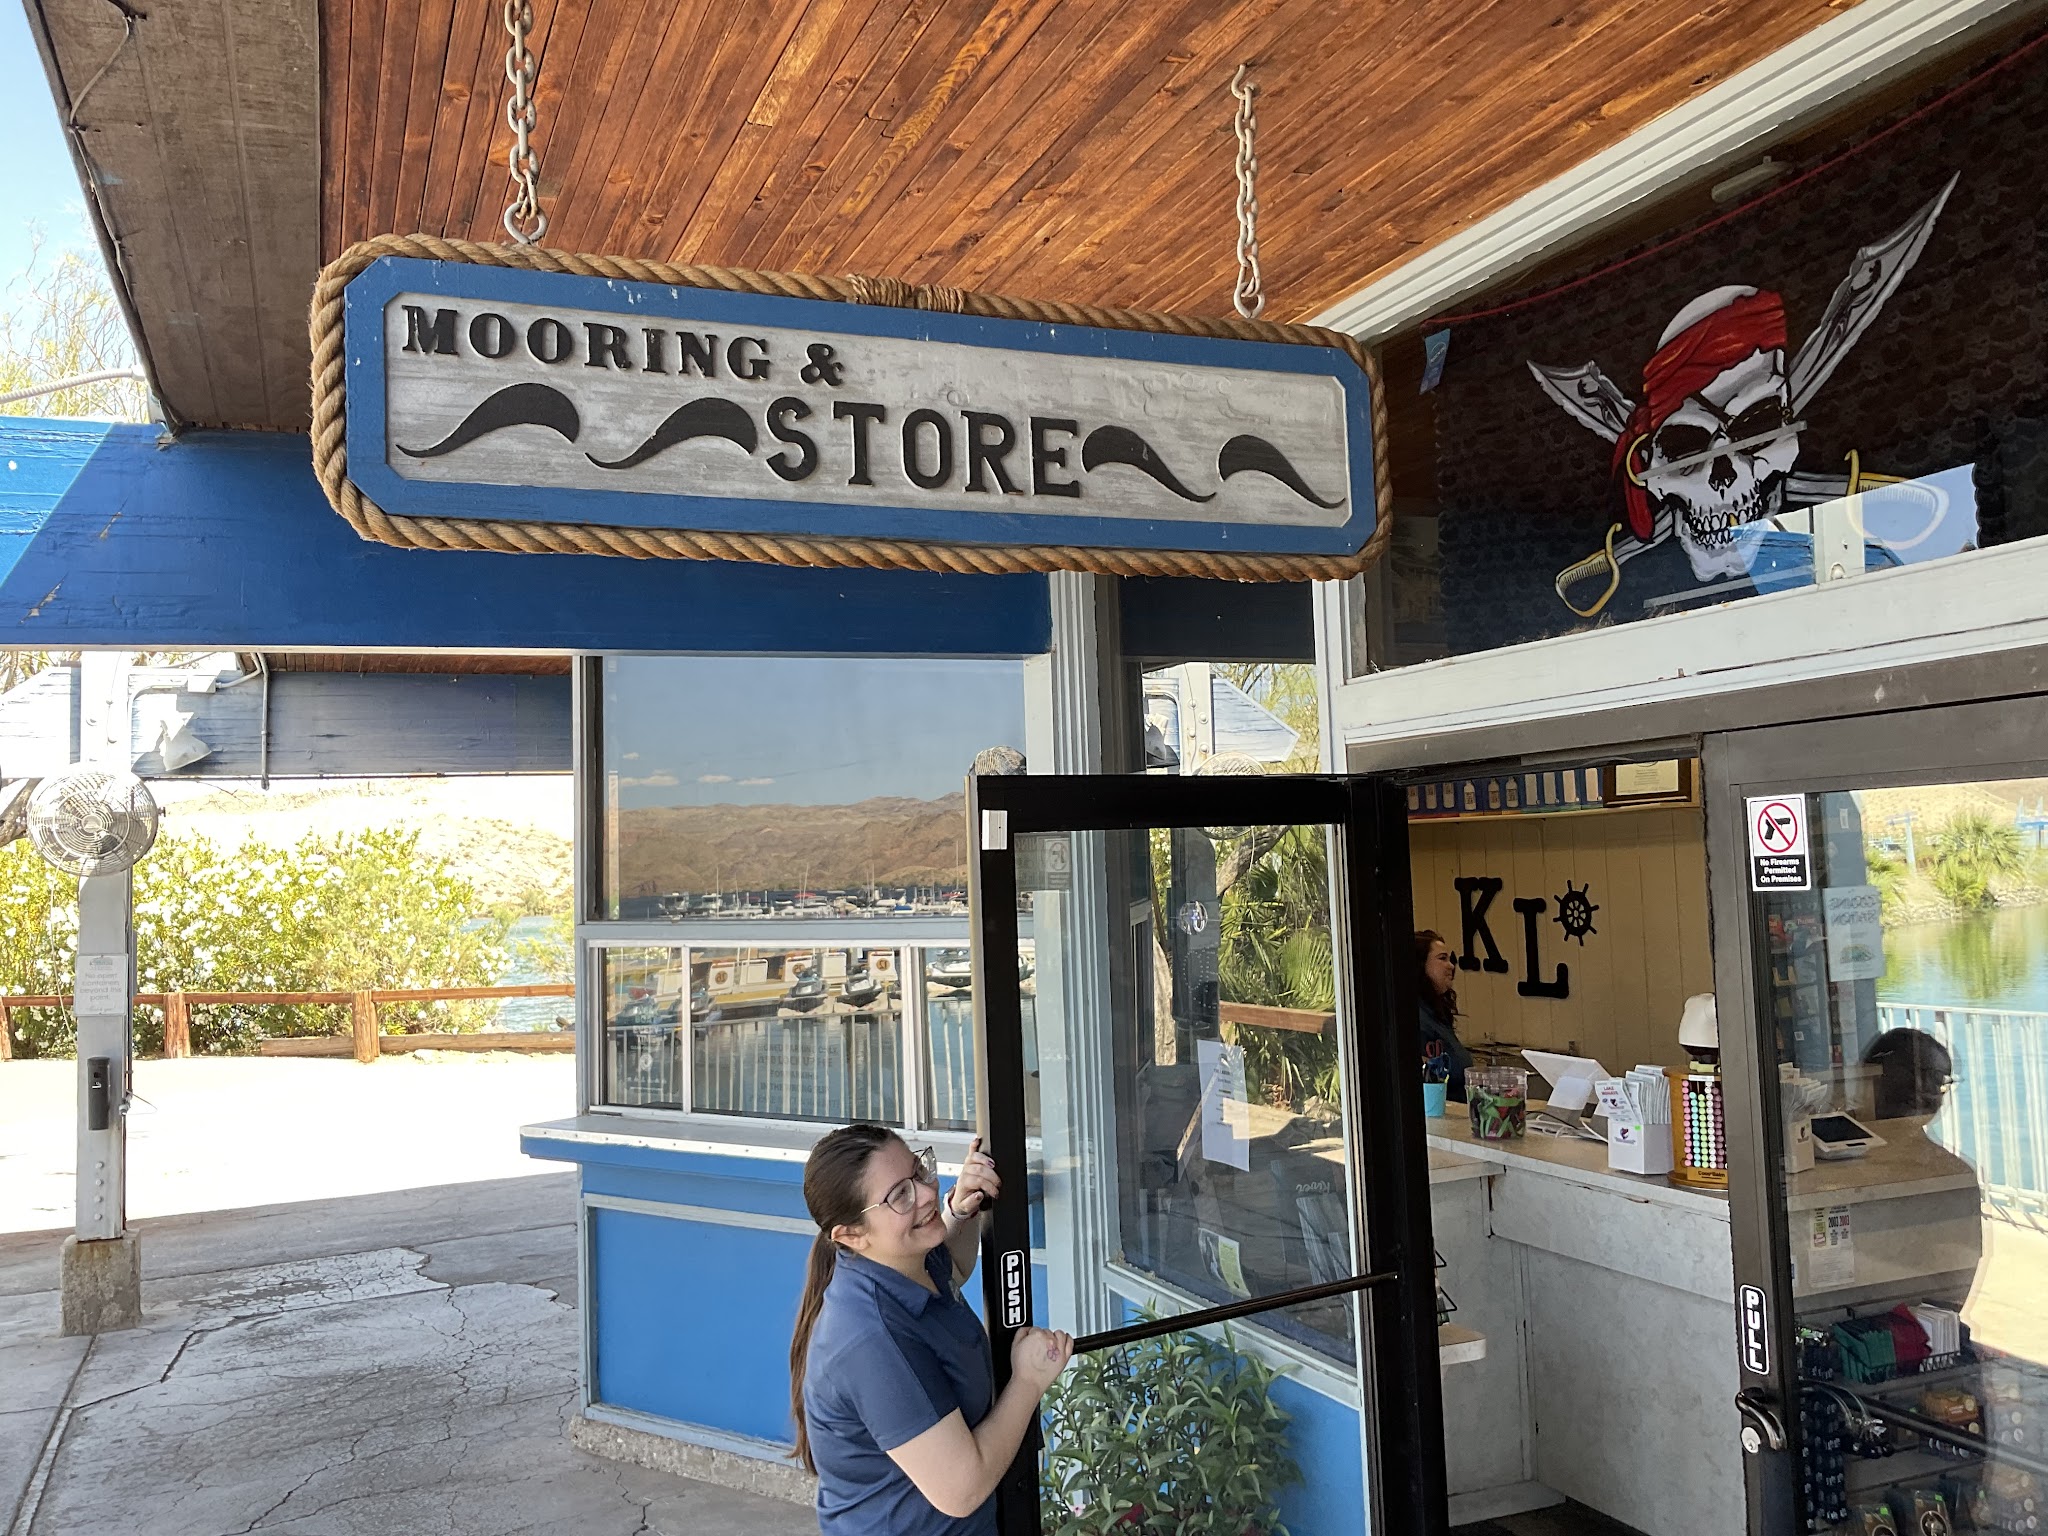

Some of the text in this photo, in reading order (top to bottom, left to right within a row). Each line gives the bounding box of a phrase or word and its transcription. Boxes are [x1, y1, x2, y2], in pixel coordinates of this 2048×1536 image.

[401, 305, 844, 387] MOORING &
[765, 396, 1081, 498] STORE
[1760, 858, 1800, 866] No Firearms
[1760, 875, 1802, 883] On Premises
[1764, 867, 1797, 875] Permitted
[1006, 1254, 1022, 1325] PUSH
[1745, 1290, 1763, 1370] PULL
